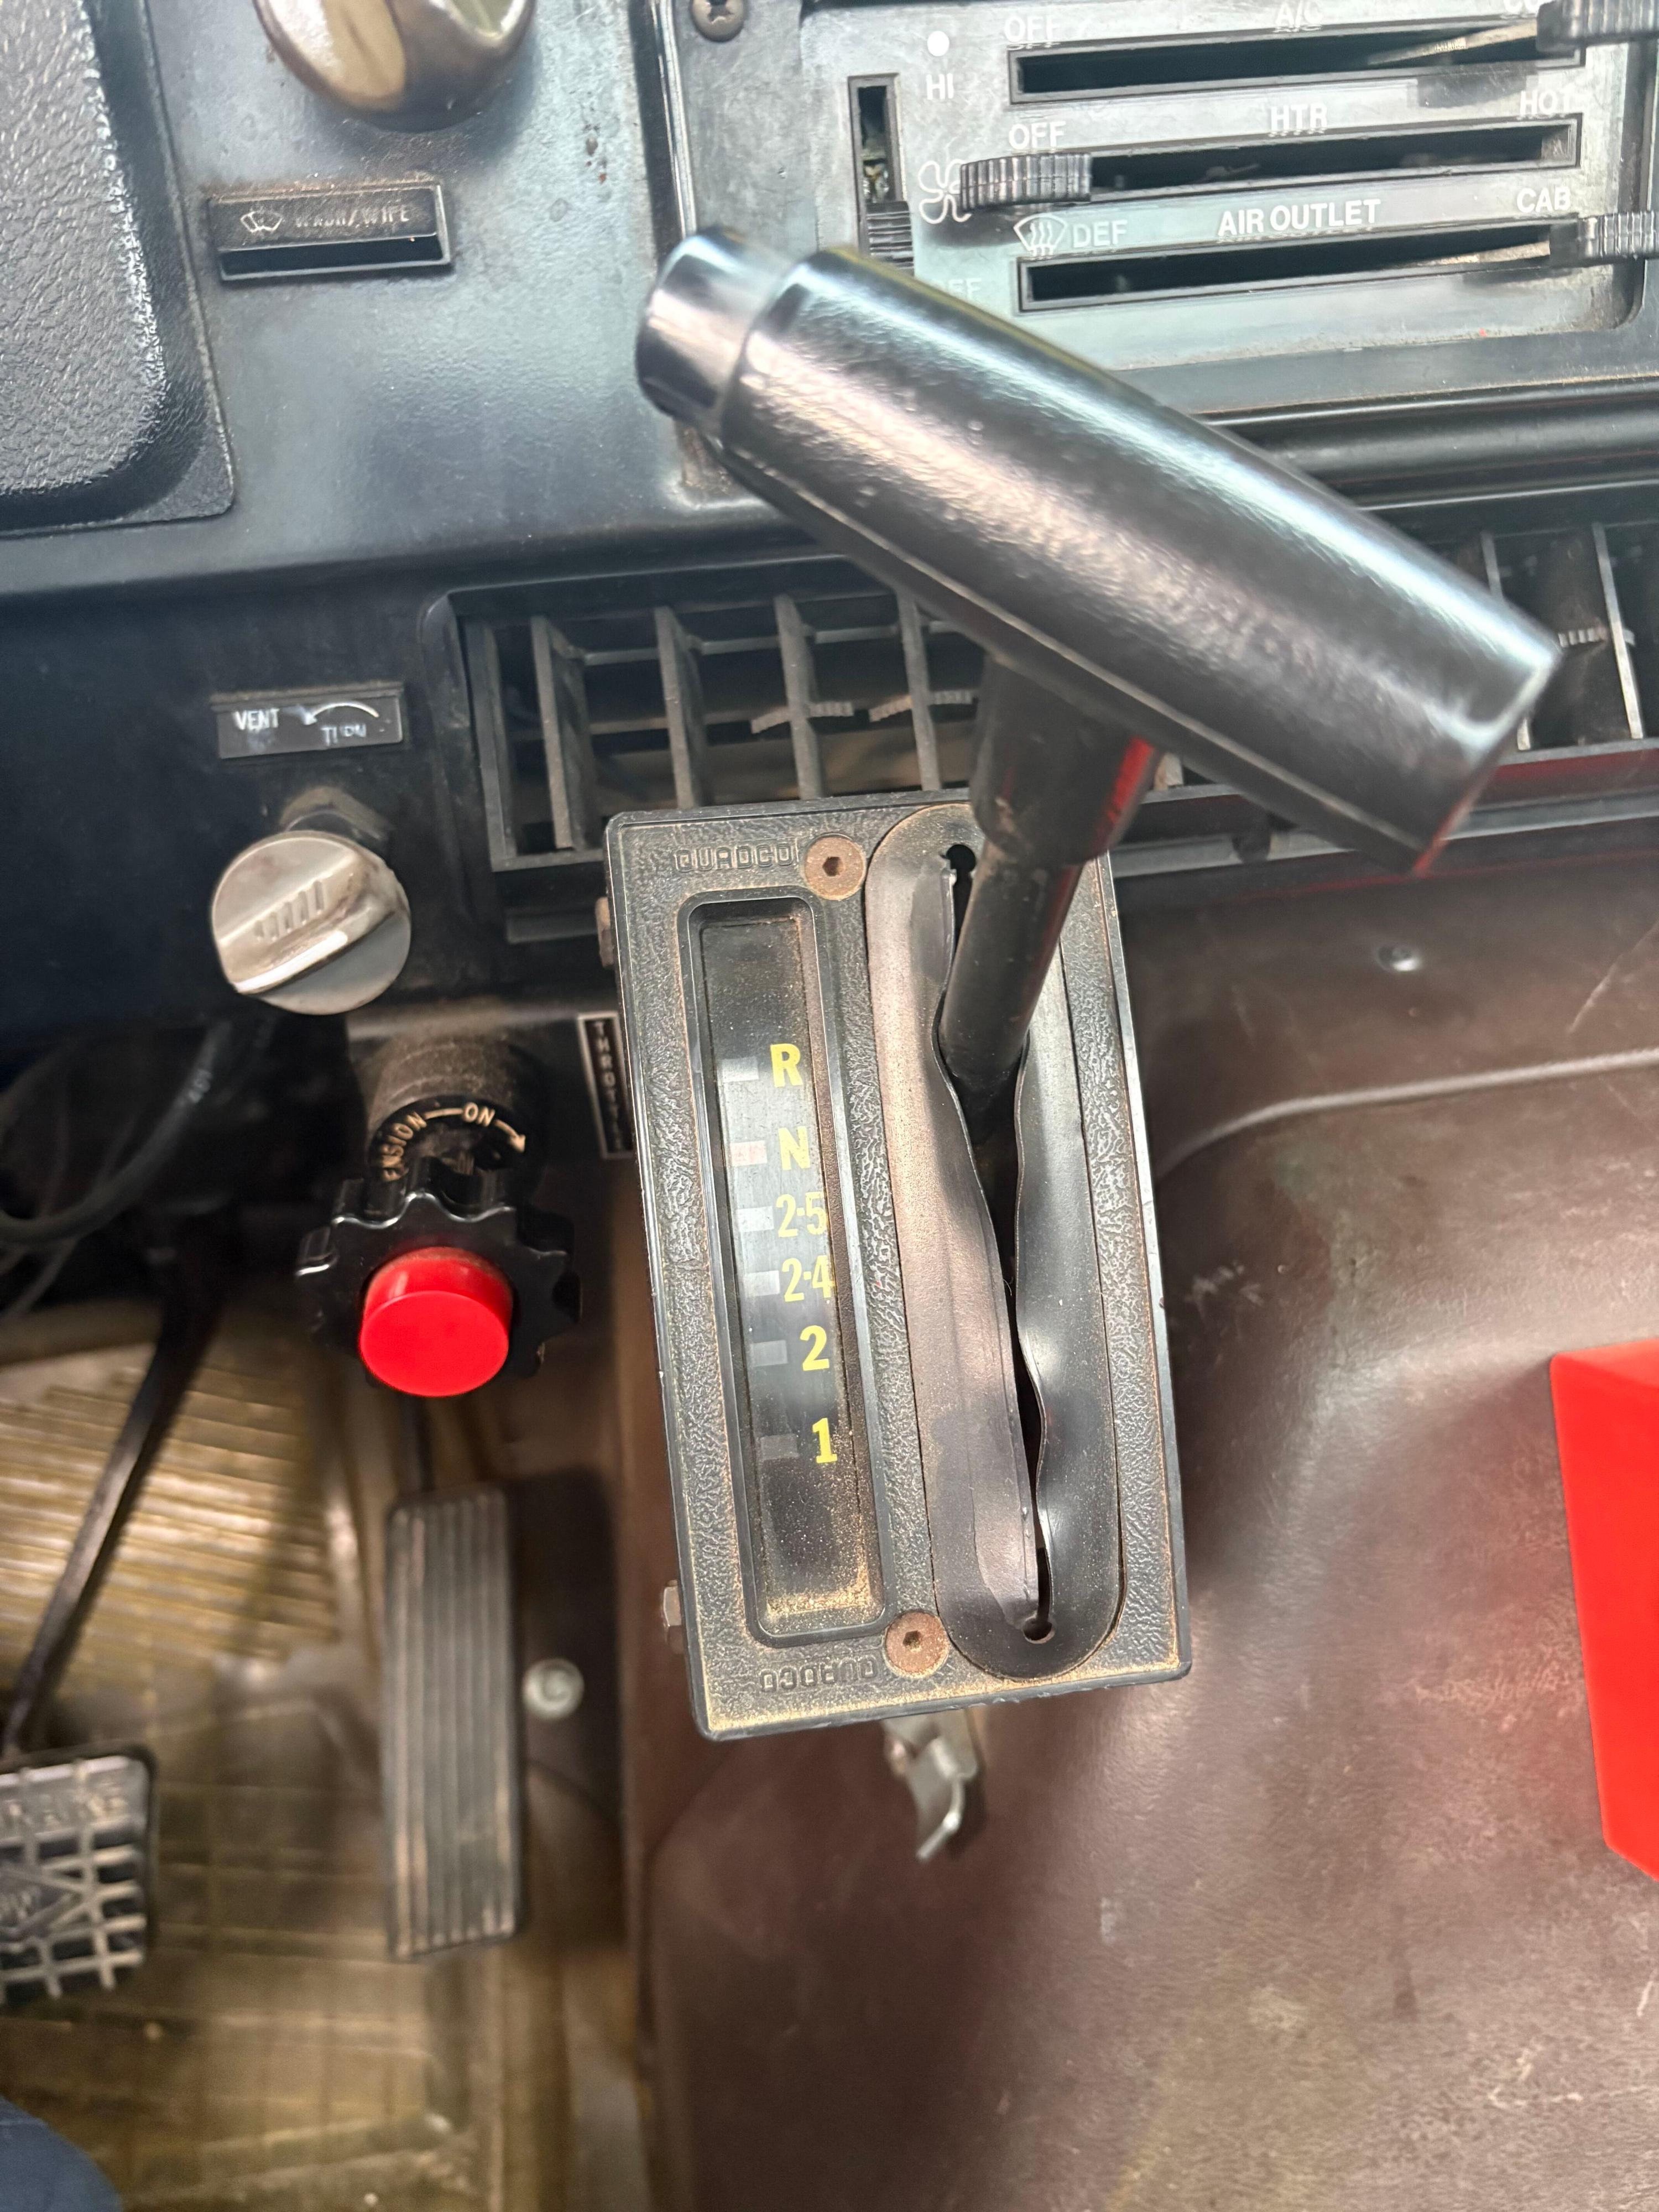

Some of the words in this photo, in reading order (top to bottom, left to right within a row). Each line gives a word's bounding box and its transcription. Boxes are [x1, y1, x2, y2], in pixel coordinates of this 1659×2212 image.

[1004, 14, 1061, 43] OFF
[926, 72, 954, 100] HI
[1520, 83, 1576, 115] HOT
[1271, 103, 1327, 132] HTR
[1008, 120, 1067, 150] OFF
[1516, 186, 1572, 213] CAB
[1218, 209, 1264, 237] AIR
[1270, 199, 1381, 231] OUTLET
[1073, 221, 1128, 248] DEF
[233, 708, 280, 731] VENT
[674, 842, 796, 873] QUADCO
[770, 1044, 803, 1087] R
[463, 1102, 496, 1127] ON
[778, 1126, 810, 1170] N
[800, 1325, 830, 1371] 2
[812, 1417, 837, 1464] 1
